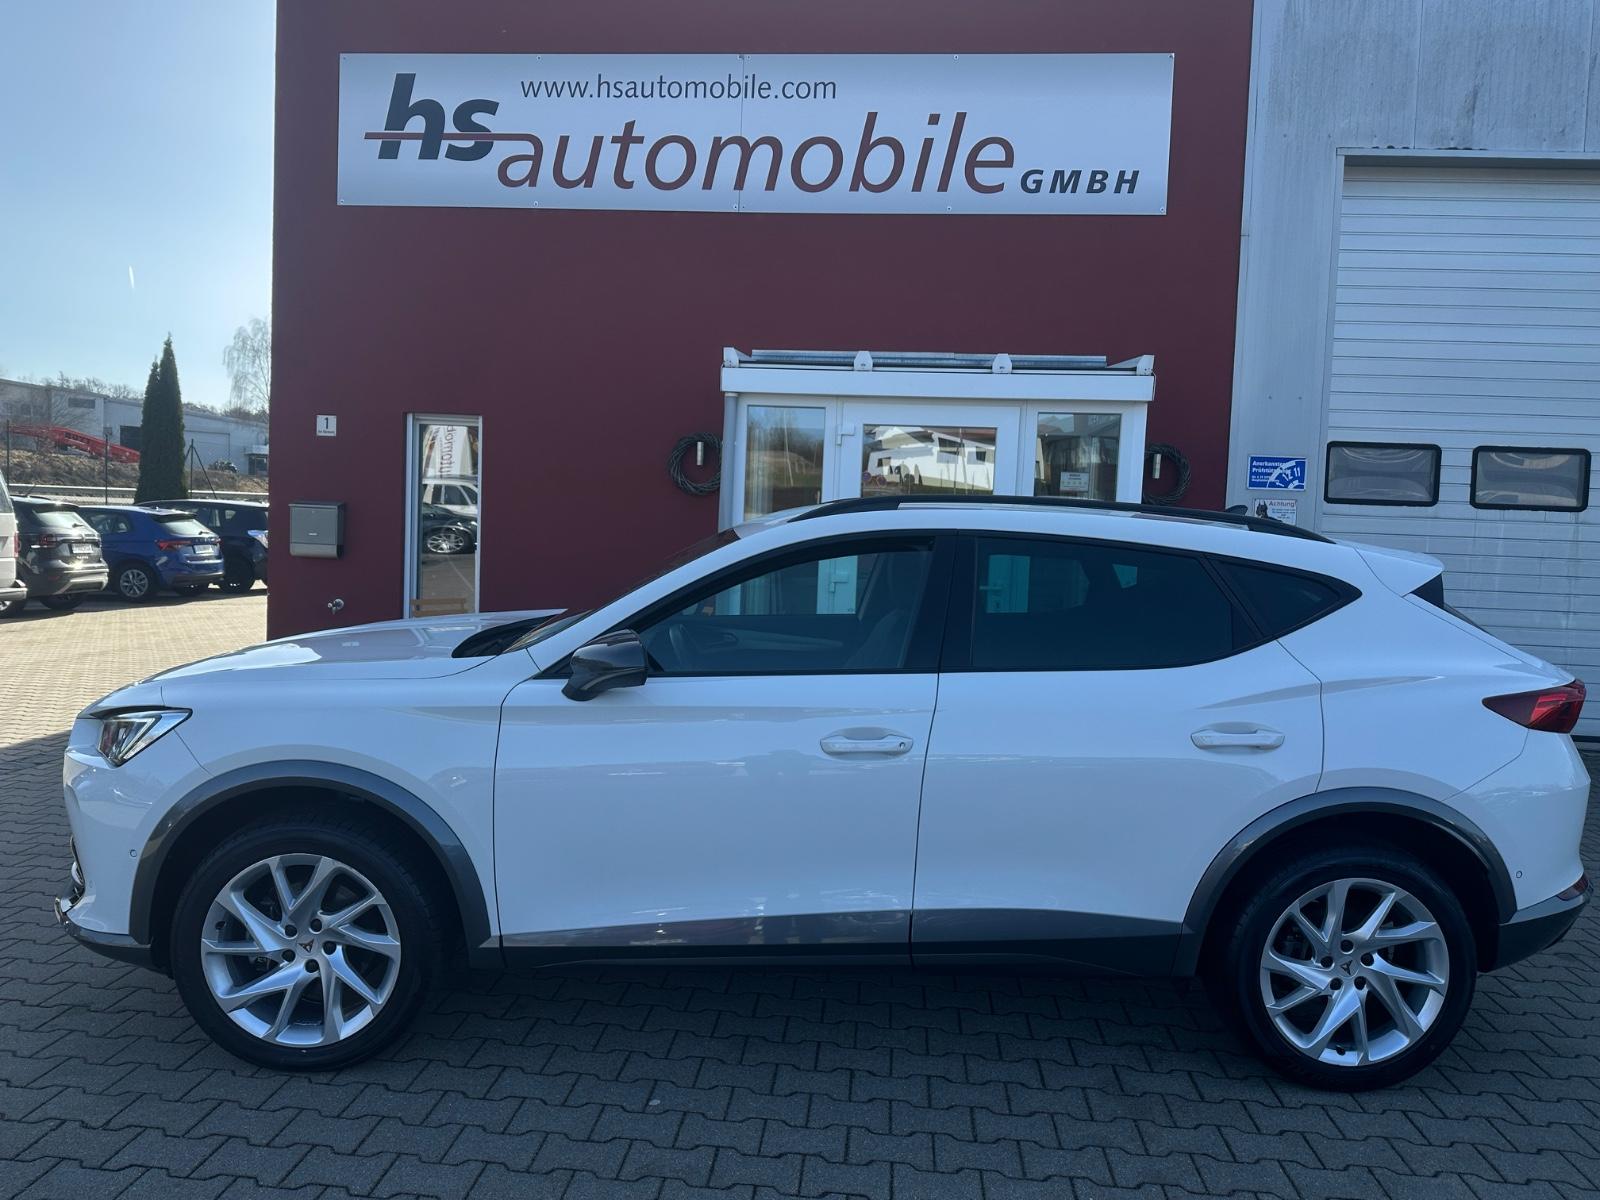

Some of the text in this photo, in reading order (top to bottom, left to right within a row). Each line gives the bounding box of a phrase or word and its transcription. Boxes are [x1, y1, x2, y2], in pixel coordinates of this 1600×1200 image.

[520, 73, 837, 99] www.hsautomobile.com
[377, 72, 1140, 195] hs automobile GMBH
[324, 417, 329, 430] 1
